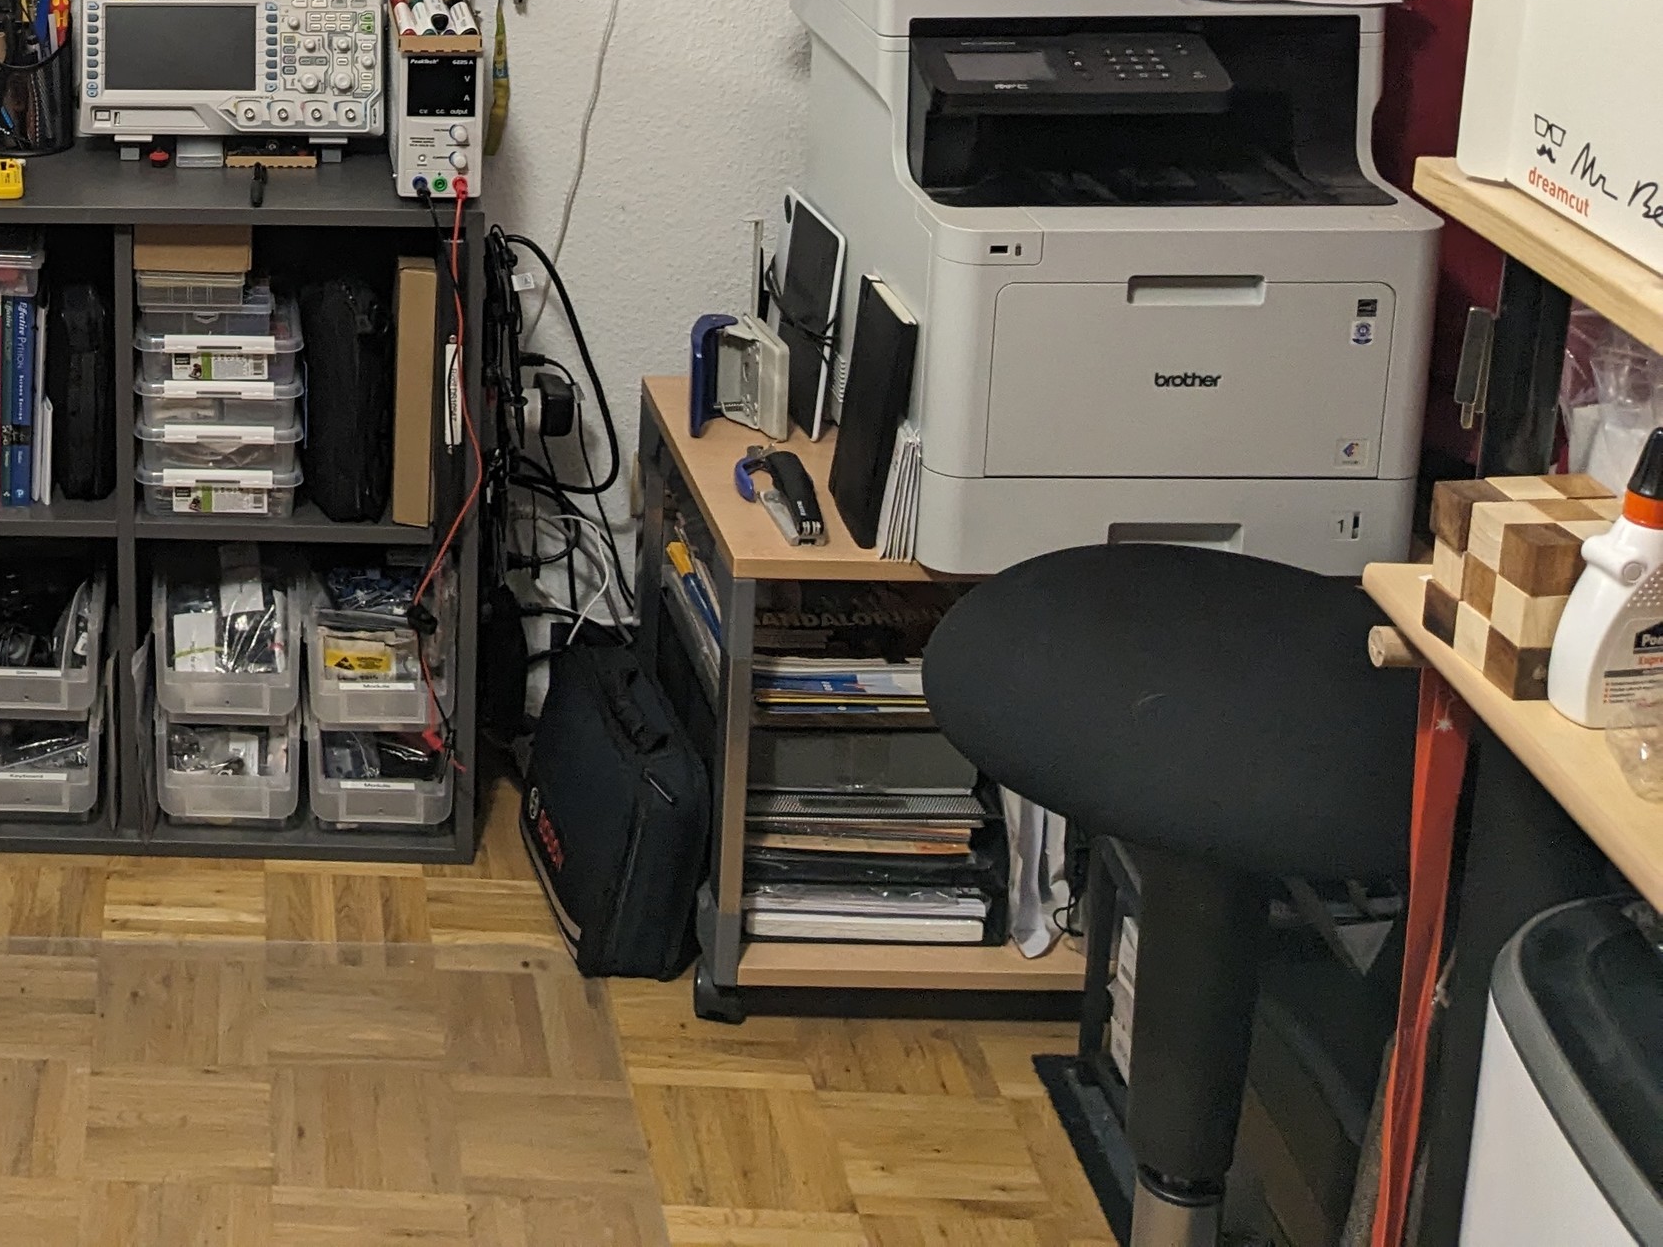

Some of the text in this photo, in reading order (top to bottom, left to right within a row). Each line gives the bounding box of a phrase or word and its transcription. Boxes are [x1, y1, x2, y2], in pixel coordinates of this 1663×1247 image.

[1528, 166, 1590, 218] dreamcut
[19, 301, 27, 336] Effective
[1154, 372, 1221, 387] brother
